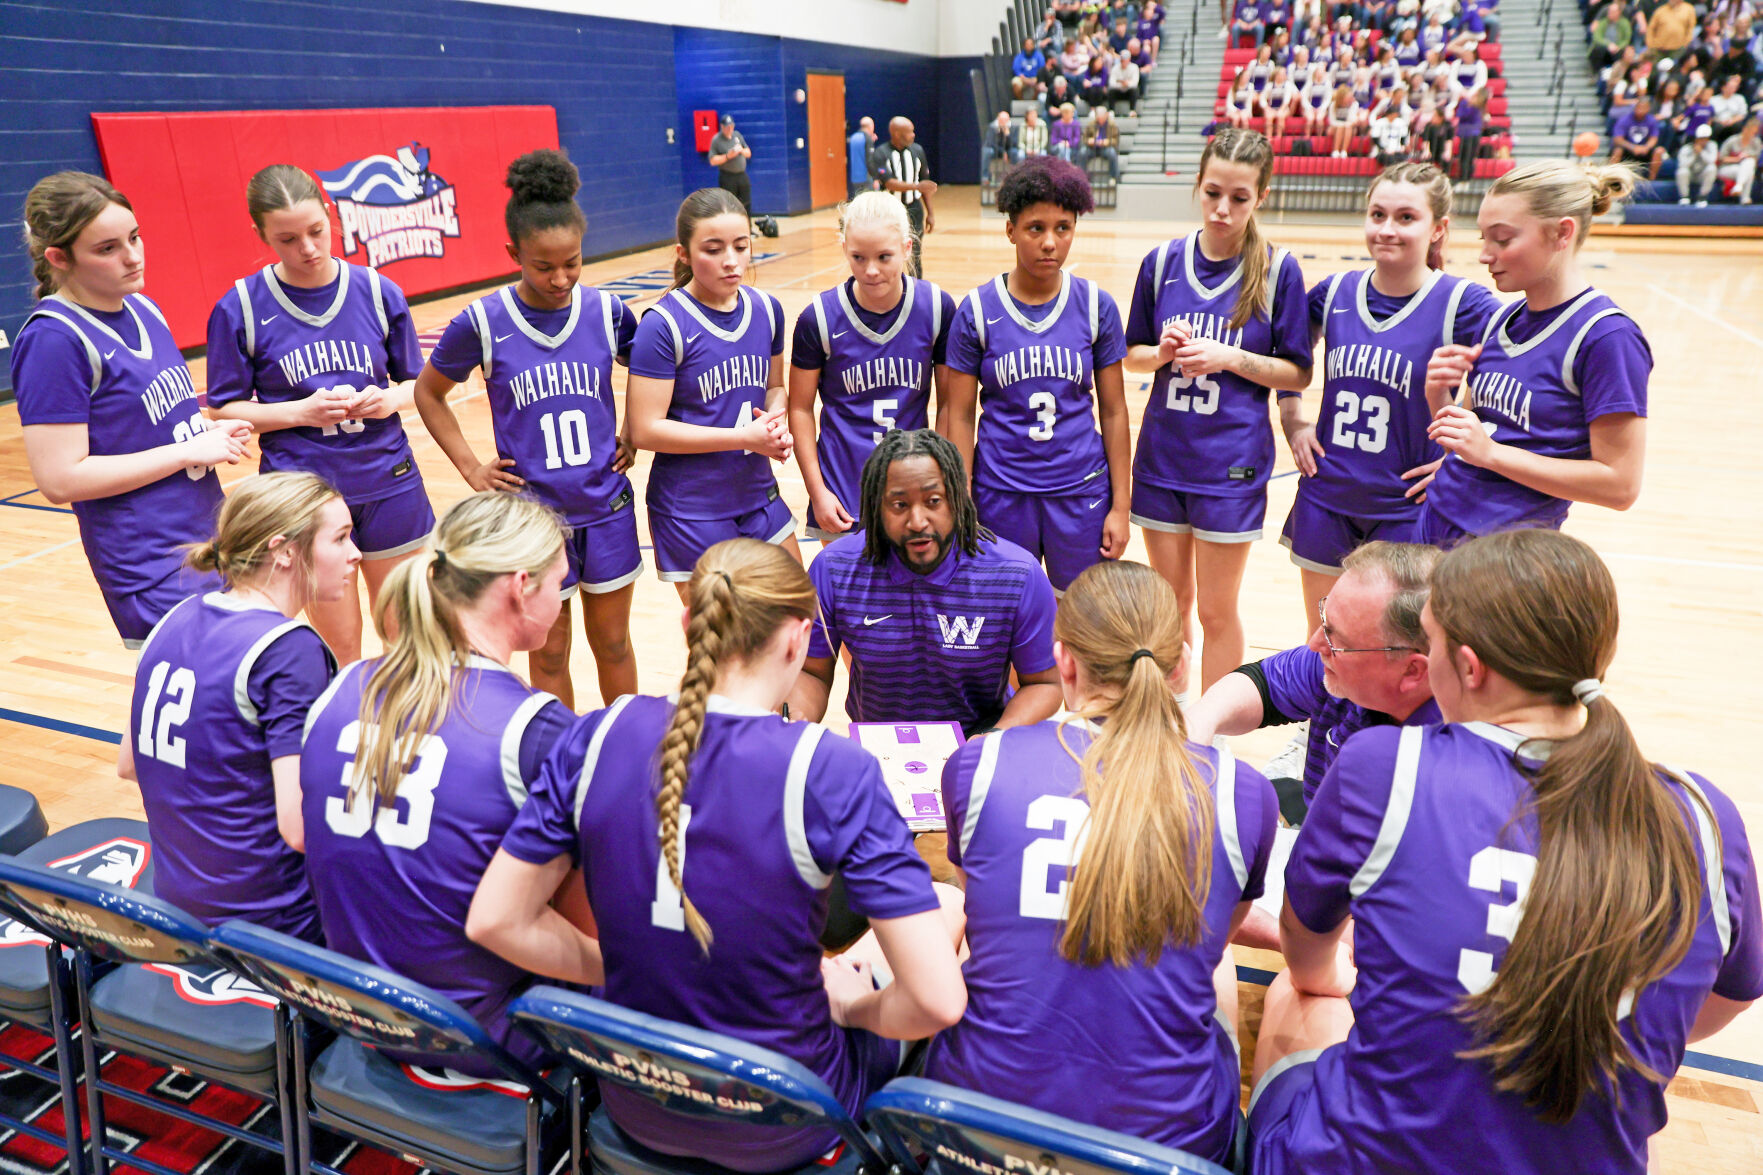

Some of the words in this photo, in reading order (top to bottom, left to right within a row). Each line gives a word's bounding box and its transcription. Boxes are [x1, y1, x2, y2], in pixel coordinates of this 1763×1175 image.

[336, 186, 460, 255] POWDERSVILLE
[367, 229, 443, 268] PATRIOTS
[1162, 312, 1243, 350] HALLA
[279, 340, 374, 387] WALHALLA
[509, 361, 601, 410] WALHALLA
[842, 357, 922, 395] WALHALLA
[994, 345, 1083, 389] WALHALLA
[1166, 357, 1222, 415] 25
[1327, 344, 1413, 399] WALHALLA
[141, 365, 197, 426] WALHAL
[1028, 391, 1056, 441] 3
[1471, 372, 1532, 432] ALHALLA
[540, 409, 592, 470] 10
[873, 399, 898, 446] 5
[1332, 390, 1390, 454] 23
[936, 614, 986, 645] W
[138, 660, 196, 770] 12
[325, 719, 448, 850] 33
[652, 803, 692, 932] 1
[1019, 795, 1092, 920] 2
[289, 978, 353, 1012] PVHS
[375, 1021, 416, 1038] CLUB
[612, 1052, 691, 1087] PVHS
[638, 1075, 714, 1104] BOOSTER
[716, 1095, 764, 1113] CLUB
[936, 1144, 1020, 1175] ATHLET
[1003, 1154, 1075, 1175] PV
